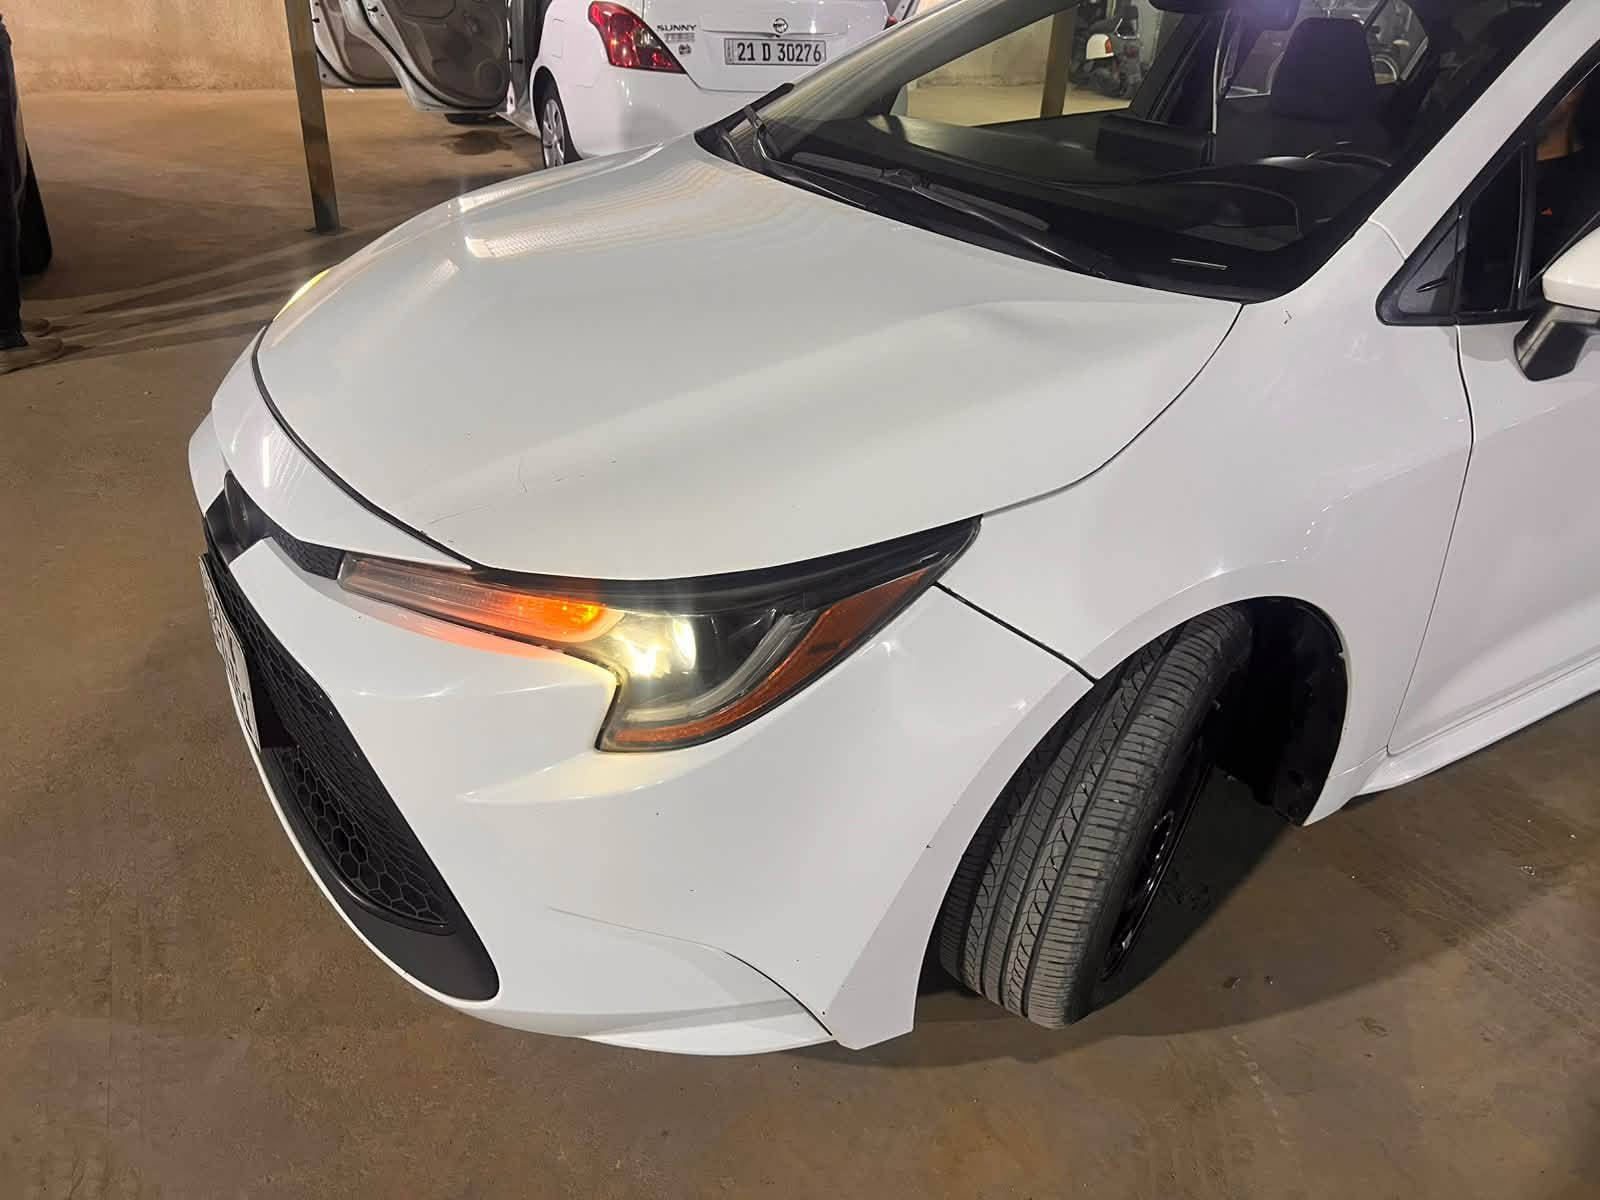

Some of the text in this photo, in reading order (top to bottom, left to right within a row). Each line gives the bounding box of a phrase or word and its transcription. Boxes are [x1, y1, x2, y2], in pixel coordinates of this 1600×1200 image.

[656, 24, 697, 32] SUNNY
[736, 42, 756, 62] 21
[762, 43, 771, 62] D
[777, 43, 822, 62] 30276
